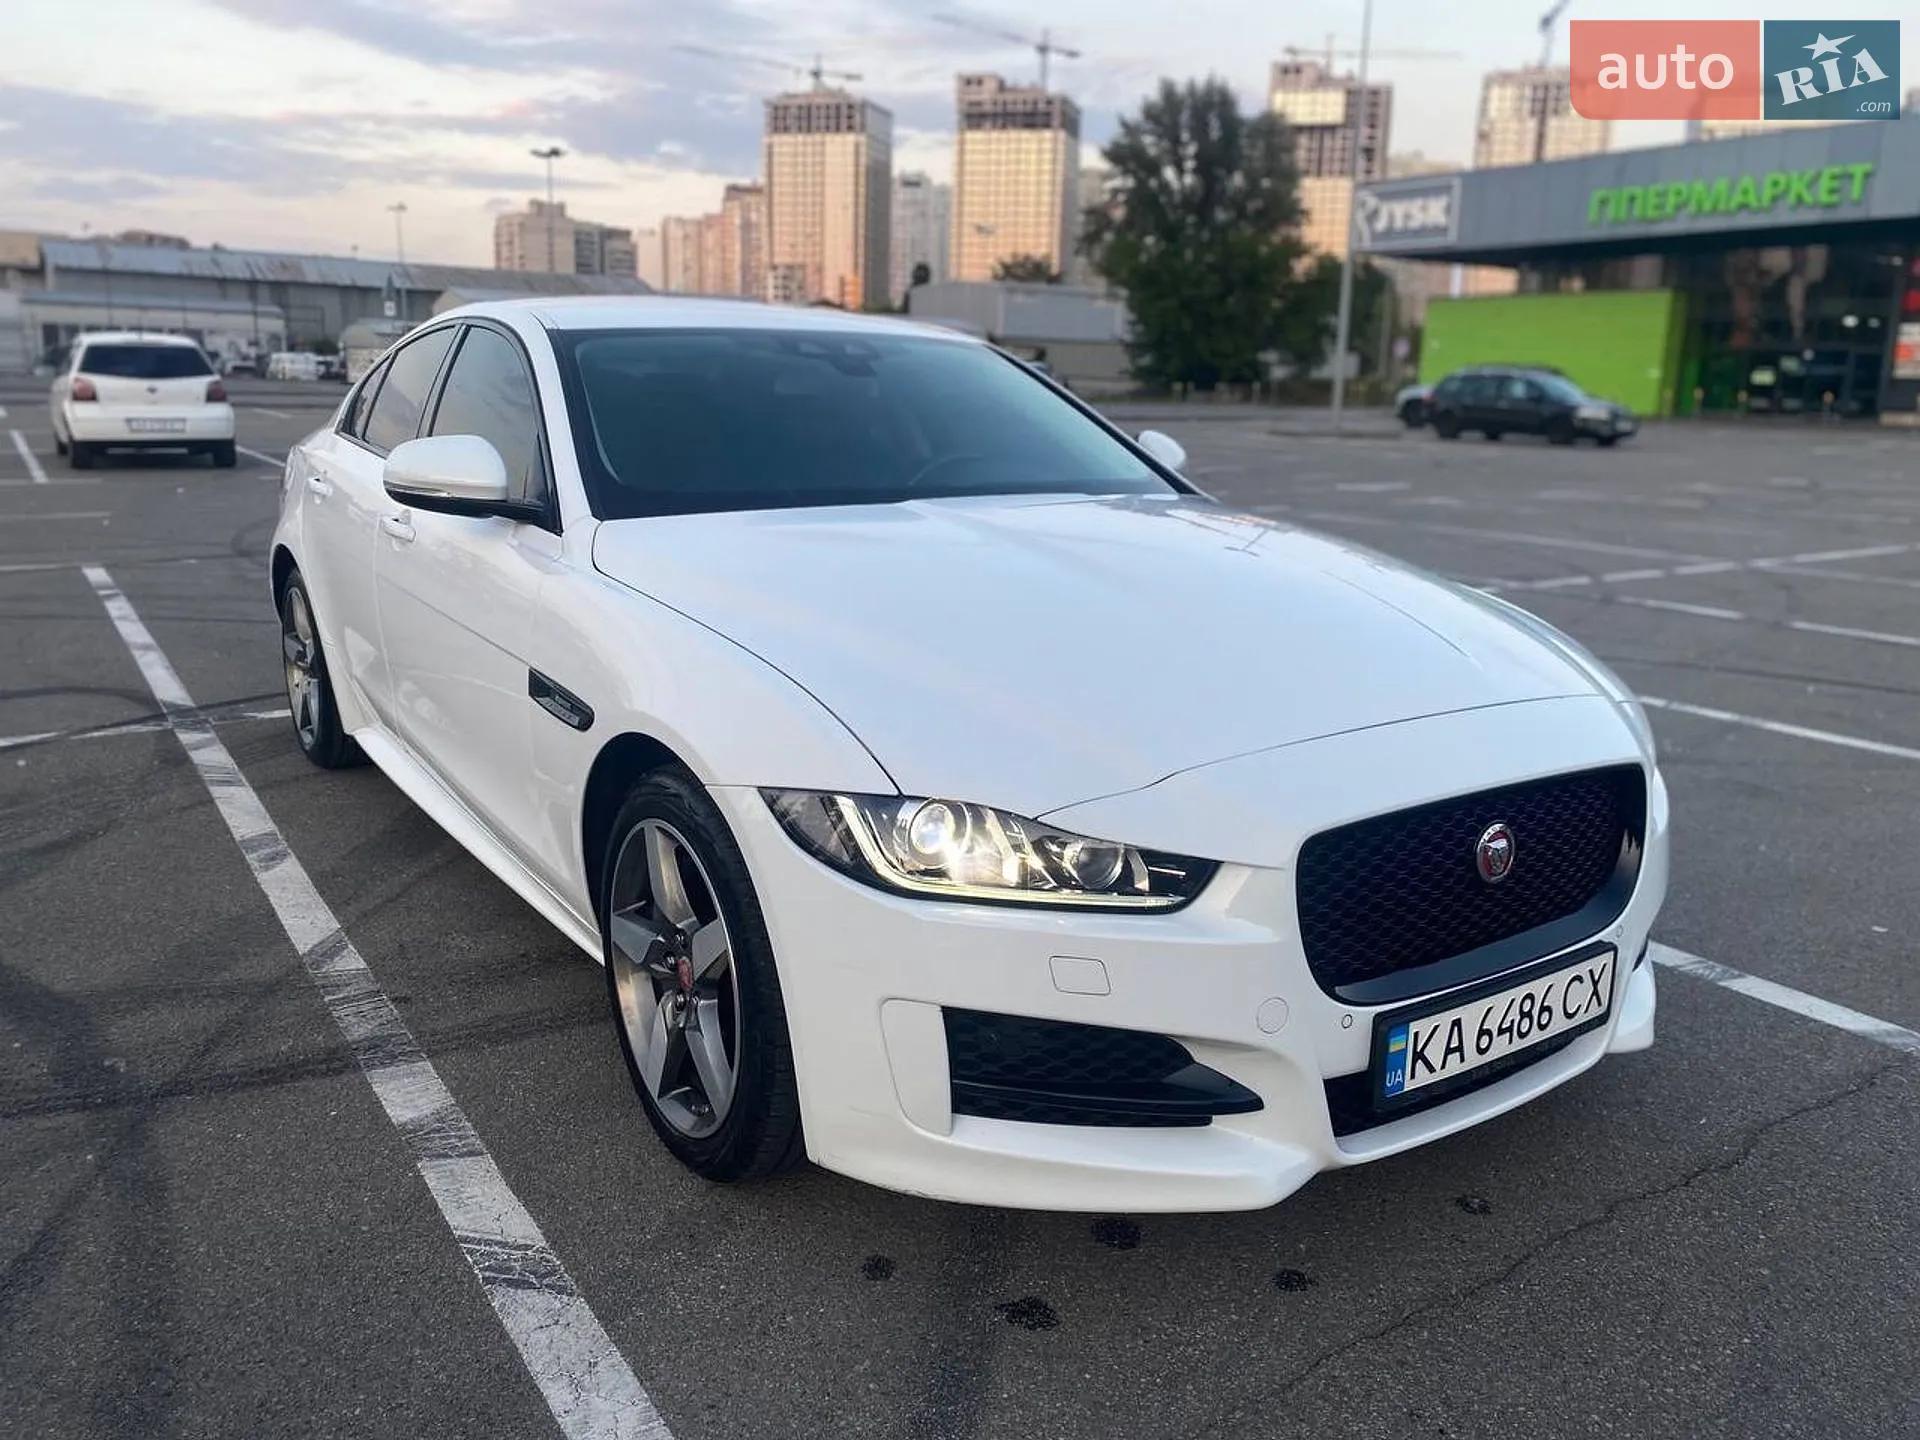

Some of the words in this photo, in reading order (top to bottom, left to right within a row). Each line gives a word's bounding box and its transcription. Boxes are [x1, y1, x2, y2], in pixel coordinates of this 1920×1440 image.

[1588, 162, 1874, 224] ГІПЕРМАРКЕТ
[1410, 1017, 1465, 1080] KA
[1475, 984, 1554, 1055] 6486
[1562, 962, 1607, 1020] CX
[1386, 1069, 1403, 1087] UA
